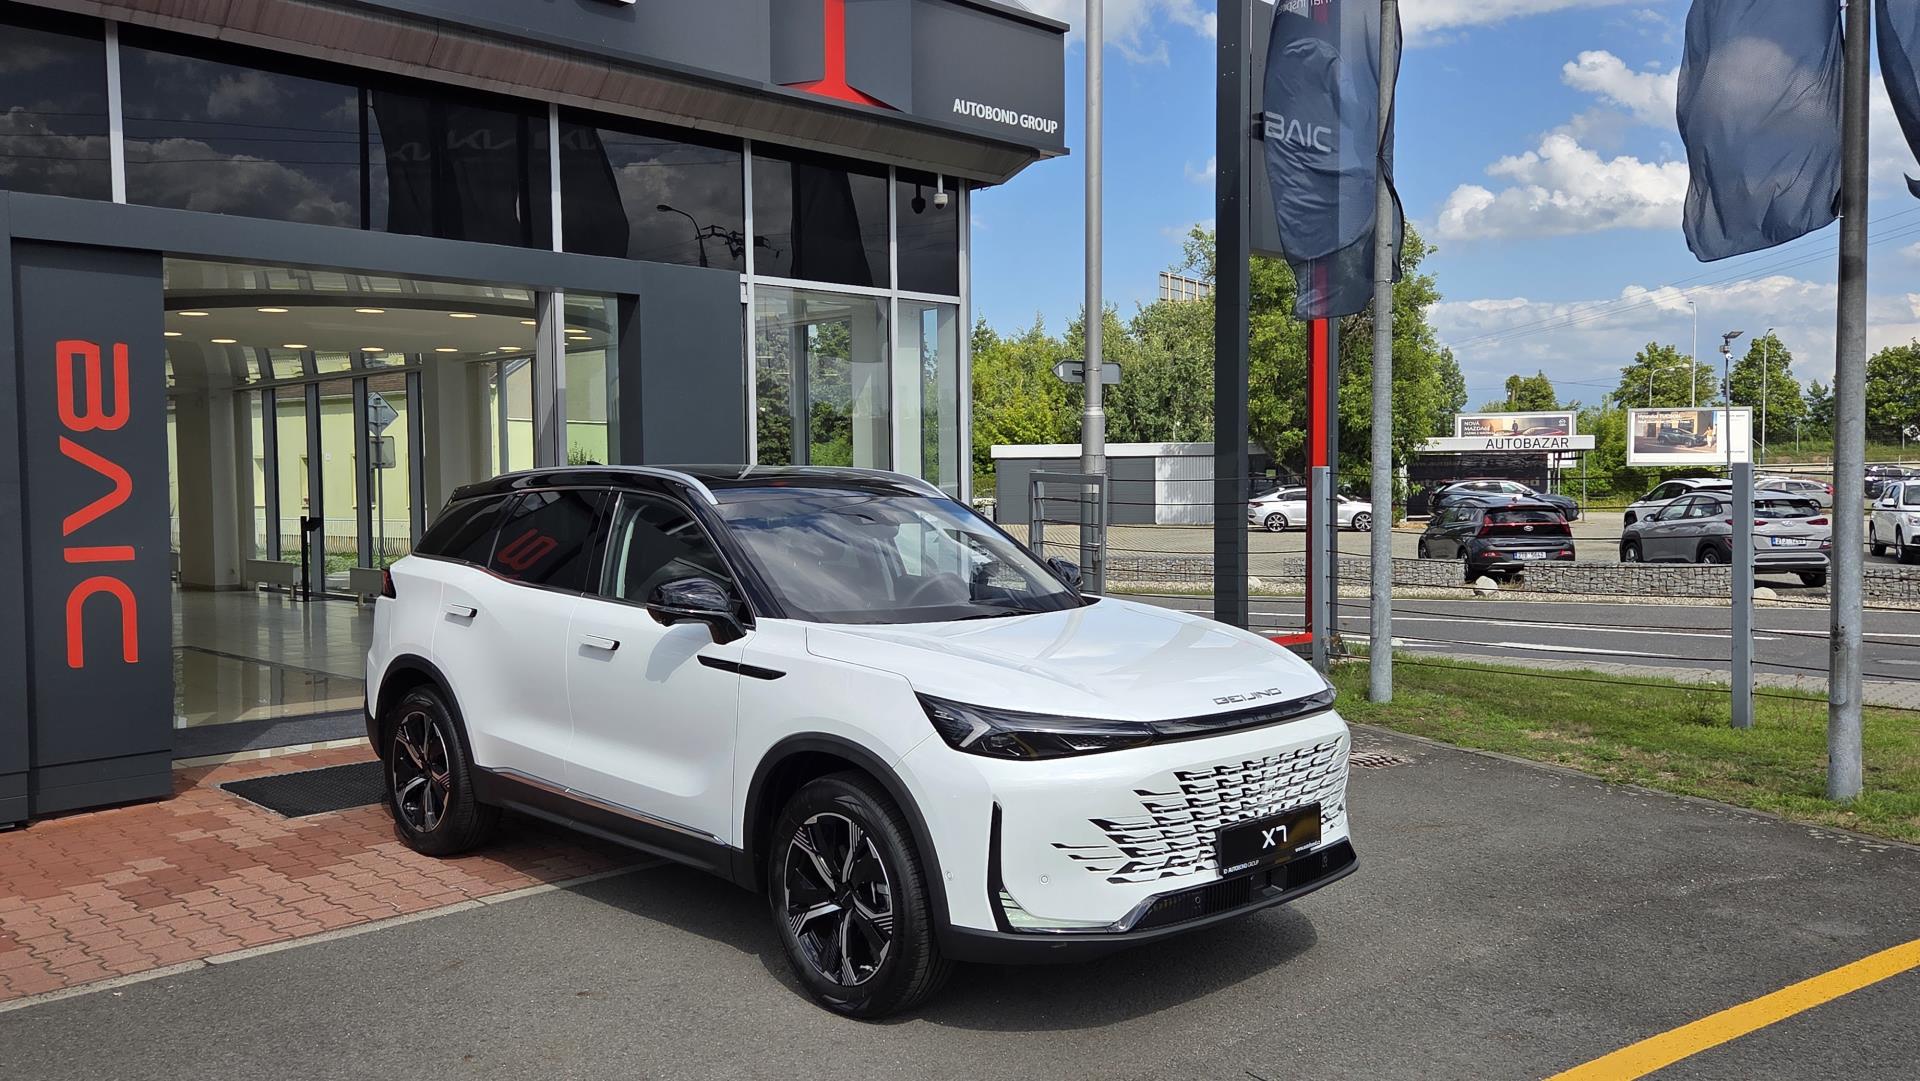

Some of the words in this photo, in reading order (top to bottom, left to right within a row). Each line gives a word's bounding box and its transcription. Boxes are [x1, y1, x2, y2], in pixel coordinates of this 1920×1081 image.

[952, 98, 1018, 125] AUTOBOND
[1019, 114, 1058, 134] GROUP
[1265, 111, 1332, 152] BAIC
[1486, 438, 1569, 450] AUTOBAZAR
[55, 339, 139, 669] BAIC
[1261, 824, 1288, 849] X7
